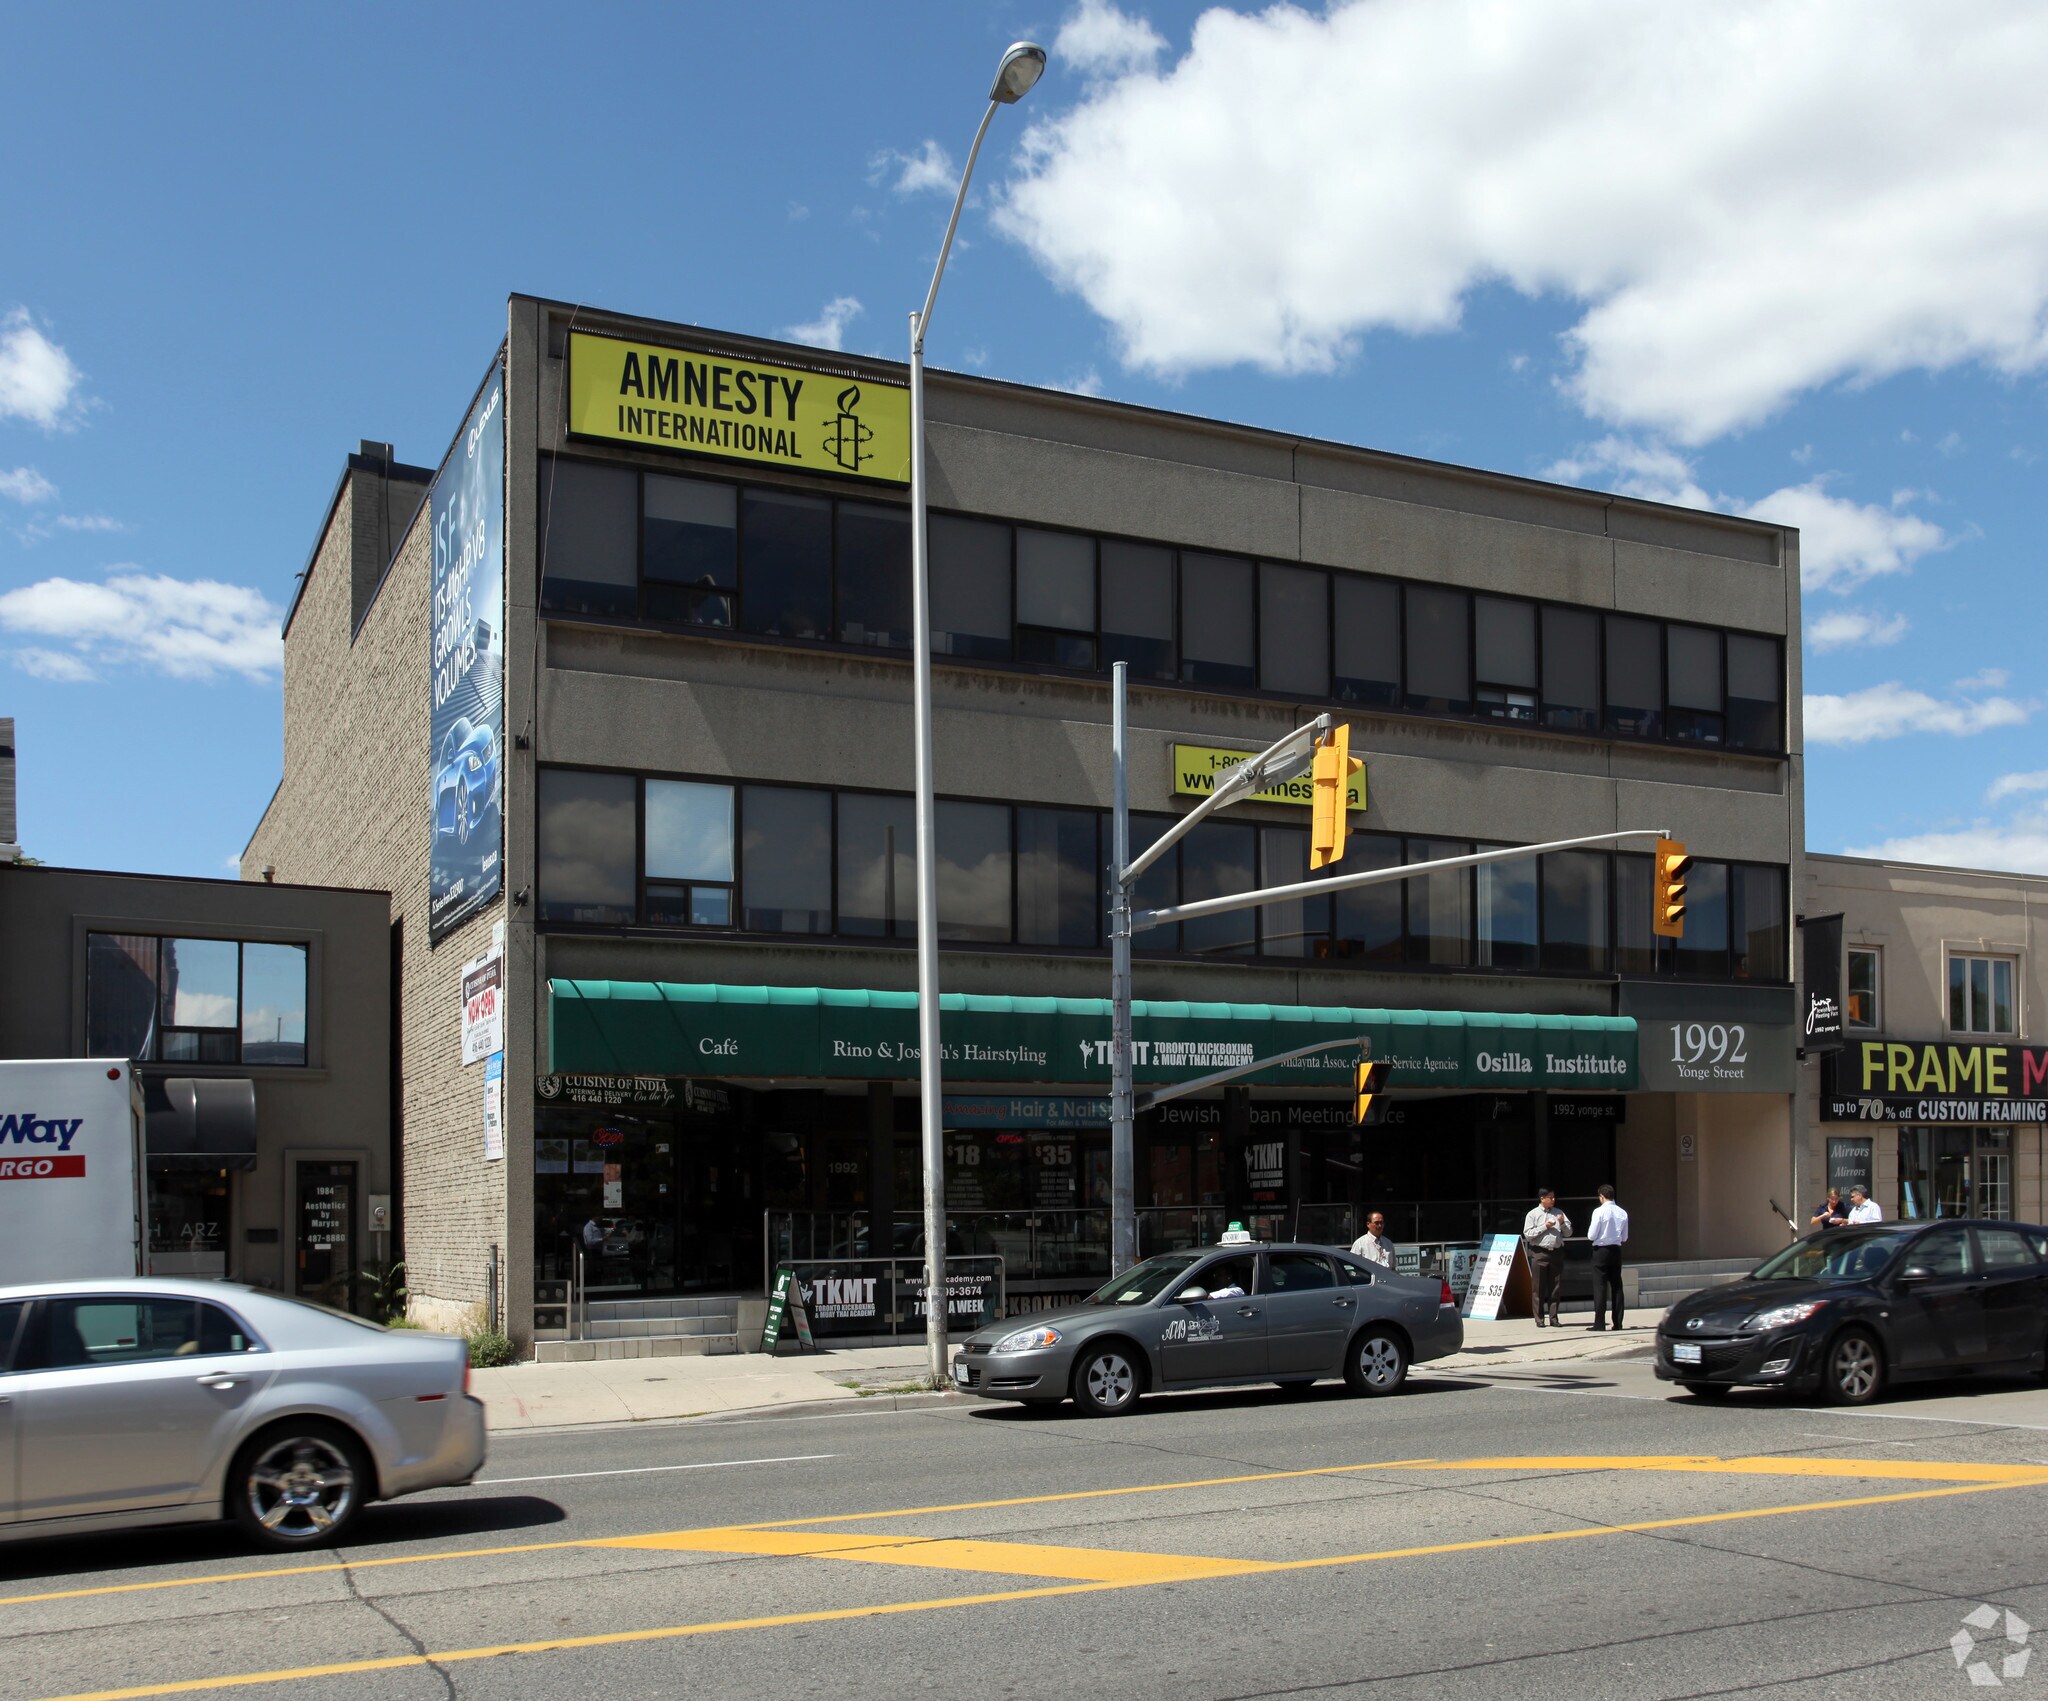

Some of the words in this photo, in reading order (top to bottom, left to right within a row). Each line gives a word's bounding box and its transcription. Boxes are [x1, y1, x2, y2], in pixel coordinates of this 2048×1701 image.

[619, 351, 804, 421] AMNESTY
[618, 405, 803, 459] INTERNATIONAL
[435, 586, 472, 669] GROWLS
[700, 1036, 740, 1056] Café
[1153, 1041, 1197, 1055] TORONTO
[1197, 1041, 1254, 1056] KICKBOXING
[1670, 1023, 1748, 1064] 1992
[833, 1040, 872, 1058] Rino
[876, 1042, 894, 1058] &
[896, 1042, 959, 1062] Josh's
[964, 1044, 1048, 1066] Hairstyling
[1152, 1055, 1160, 1066] &
[1161, 1054, 1188, 1067] MUAY
[1188, 1054, 1210, 1067] THAI
[1211, 1055, 1255, 1068] ACADEMY
[1322, 1054, 1350, 1070] Assoc.
[1392, 1055, 1421, 1070] Service
[1423, 1056, 1459, 1074] Agencies
[1476, 1052, 1534, 1073] Osilla
[1546, 1053, 1627, 1074] Institute
[1862, 1041, 2008, 1096] FRAME
[1678, 1064, 1710, 1080] Yonge
[1713, 1065, 1745, 1079] Street
[566, 1076, 616, 1090] CUISINE
[617, 1078, 634, 1090] OF
[634, 1077, 668, 1092] INDIA
[566, 1088, 597, 1097] CATERING
[572, 1094, 586, 1103] 416
[587, 1094, 603, 1104] 440
[604, 1096, 623, 1105] 1220
[1010, 1101, 1045, 1118] Hair
[1047, 1102, 1059, 1118] &
[1062, 1102, 1096, 1118] Nail
[1160, 1106, 1220, 1124] Jewish
[1249, 1106, 1282, 1124] ban
[1287, 1106, 1357, 1127] Meeting
[1553, 1104, 1575, 1116] 1992
[1576, 1106, 1603, 1118] yonge
[1833, 1103, 1846, 1116] up
[1847, 1101, 1857, 1114] to
[1900, 1106, 1914, 1119] off
[1918, 1100, 1979, 1121] CUSTOM
[1982, 1101, 2047, 1121] FRAMING
[946, 1144, 980, 1166] $18
[1034, 1144, 1072, 1166] $35
[1252, 1142, 1285, 1170] TKMT
[1830, 1144, 1870, 1158] Mirrors
[0, 1159, 54, 1177] RGO
[828, 1161, 858, 1174] 1992
[1834, 1166, 1866, 1178] Mirrors
[316, 1186, 335, 1196] 1984
[305, 1201, 346, 1210] Aesthetics
[320, 1210, 331, 1219] by
[311, 1219, 340, 1228] Maryse
[904, 1275, 992, 1285] wwwcademy.com
[813, 1278, 877, 1305] TKMT
[947, 1301, 957, 1314] A
[956, 1299, 985, 1313] WEEK
